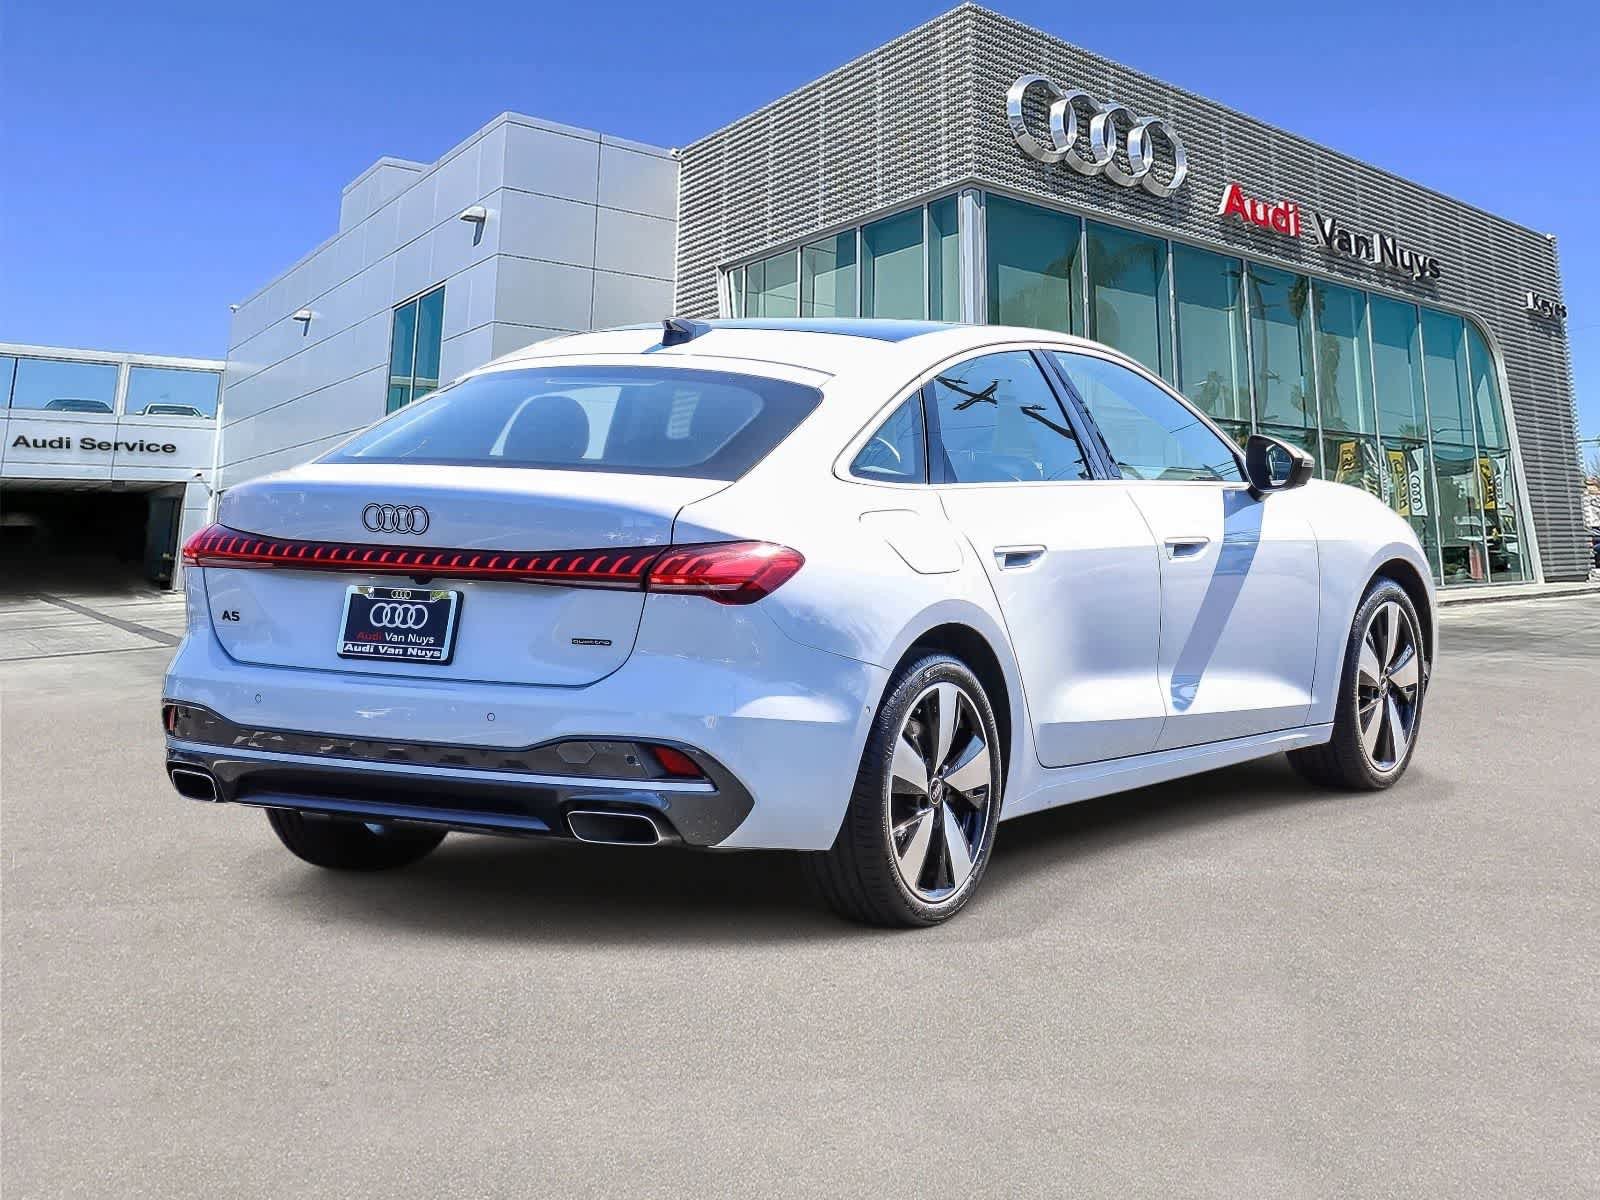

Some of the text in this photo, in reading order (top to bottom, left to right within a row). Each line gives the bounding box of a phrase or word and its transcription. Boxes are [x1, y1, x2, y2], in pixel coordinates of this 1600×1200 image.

[1218, 183, 1441, 281] Audi Van Nuys
[12, 435, 177, 453] Audi Service
[222, 609, 240, 622] A5
[356, 631, 435, 645] Audi Van Nuys
[344, 643, 441, 658] Audi Van Nuys
